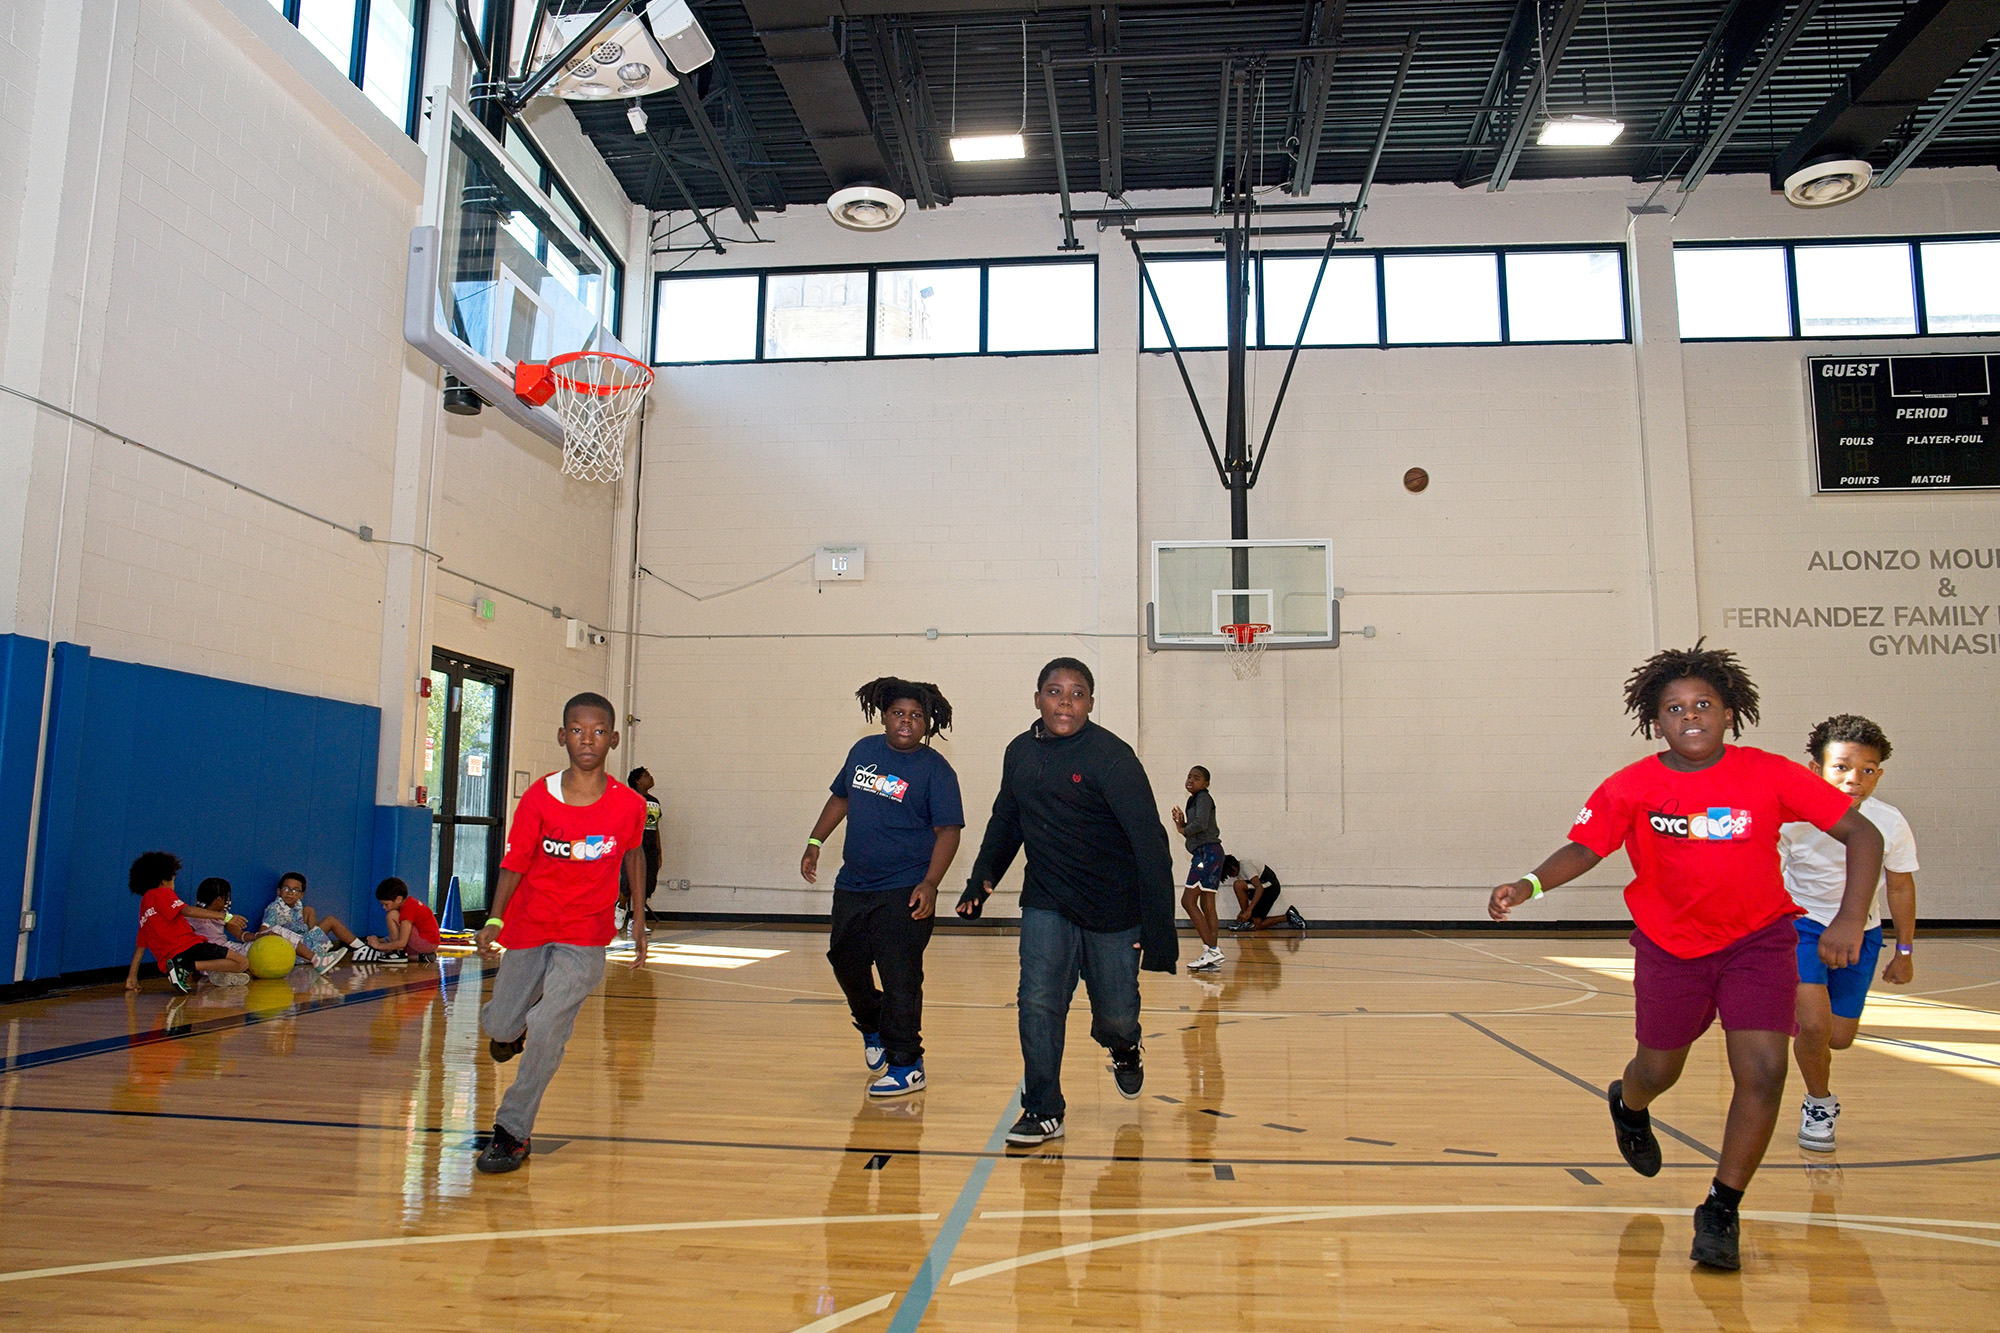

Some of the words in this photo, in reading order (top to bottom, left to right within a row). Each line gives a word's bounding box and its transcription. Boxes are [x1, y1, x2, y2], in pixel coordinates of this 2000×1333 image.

[1822, 363, 1880, 378] GUEST
[1895, 407, 1948, 419] PERIOD
[1839, 437, 1874, 446] FOULS
[1906, 434, 1984, 445] PLAYER-FOUL
[1839, 476, 1880, 485] POINTS
[1911, 474, 1951, 484] MATCH
[1807, 549, 1921, 572] ALONZO
[1929, 548, 2000, 570] MOU
[1937, 576, 1958, 598] &
[1722, 605, 1886, 629] FERNANDEZ
[1893, 604, 1991, 627] FAMILY
[1868, 633, 2000, 657] GYMNASI
[856, 773, 876, 786] OYC
[1650, 815, 1688, 835] OYC
[542, 839, 571, 857] OYC
